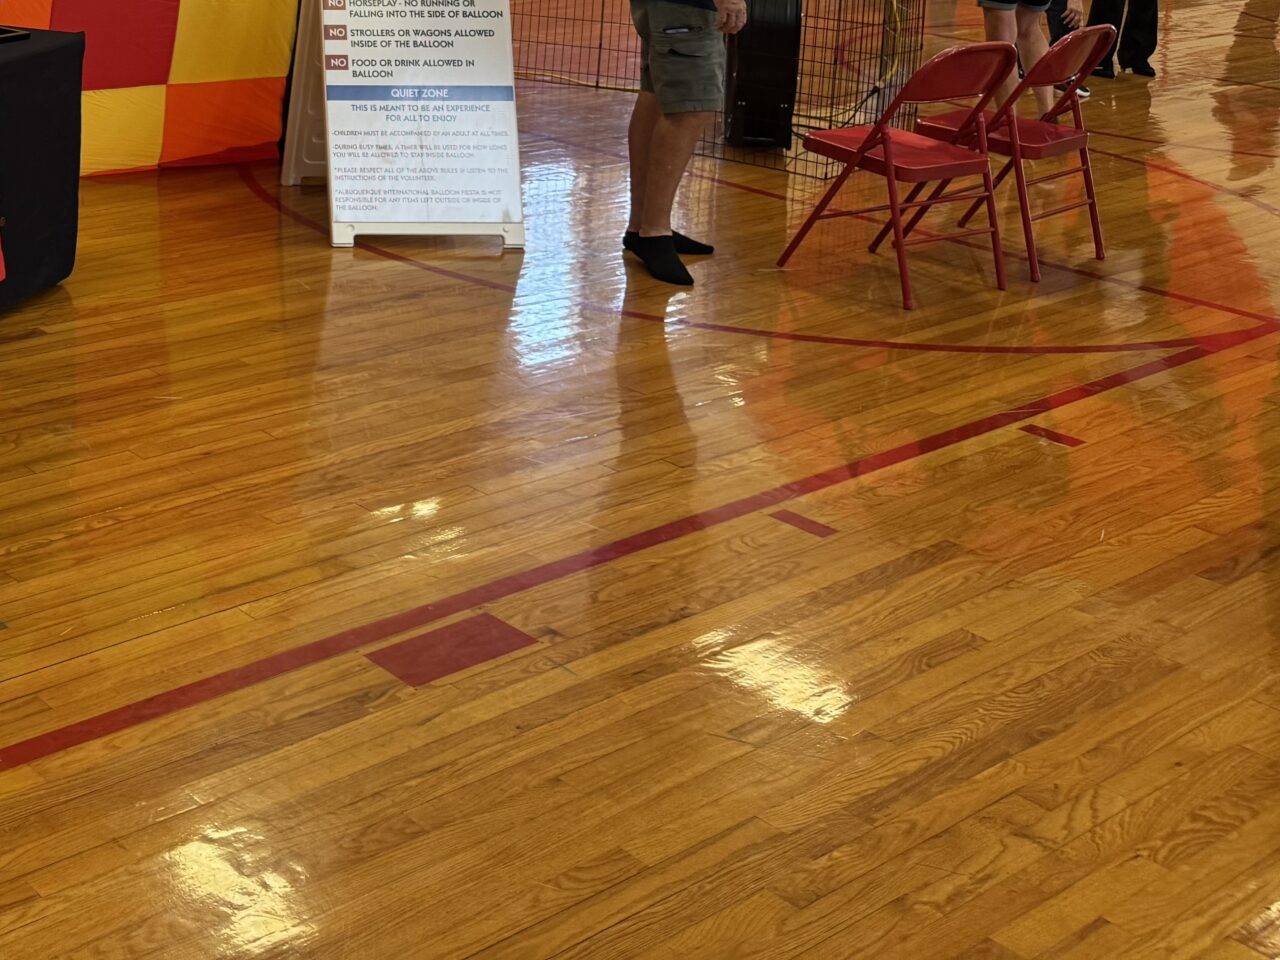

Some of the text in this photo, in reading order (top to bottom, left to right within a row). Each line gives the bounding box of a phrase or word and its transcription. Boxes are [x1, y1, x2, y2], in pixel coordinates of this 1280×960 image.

[328, 0, 344, 7] NO
[349, 0, 397, 7] HORSEPLAY
[404, 0, 418, 7] NO
[420, 0, 460, 7] RUNNING
[462, 0, 476, 7] OR
[350, 10, 503, 18] FALLING INTO THE SIDE OF BALLOON
[329, 28, 345, 36] NO
[350, 29, 495, 37] STROLLERS OR WAGONS ALLOWED
[350, 40, 454, 48] INSIDE OF THE BALLOON
[330, 58, 346, 66] NO
[352, 70, 393, 78] BALLOON
[391, 88, 448, 98] QUIET ZONE
[351, 104, 490, 112] THIS IS MEANT TO BE AN EXPERIENCE
